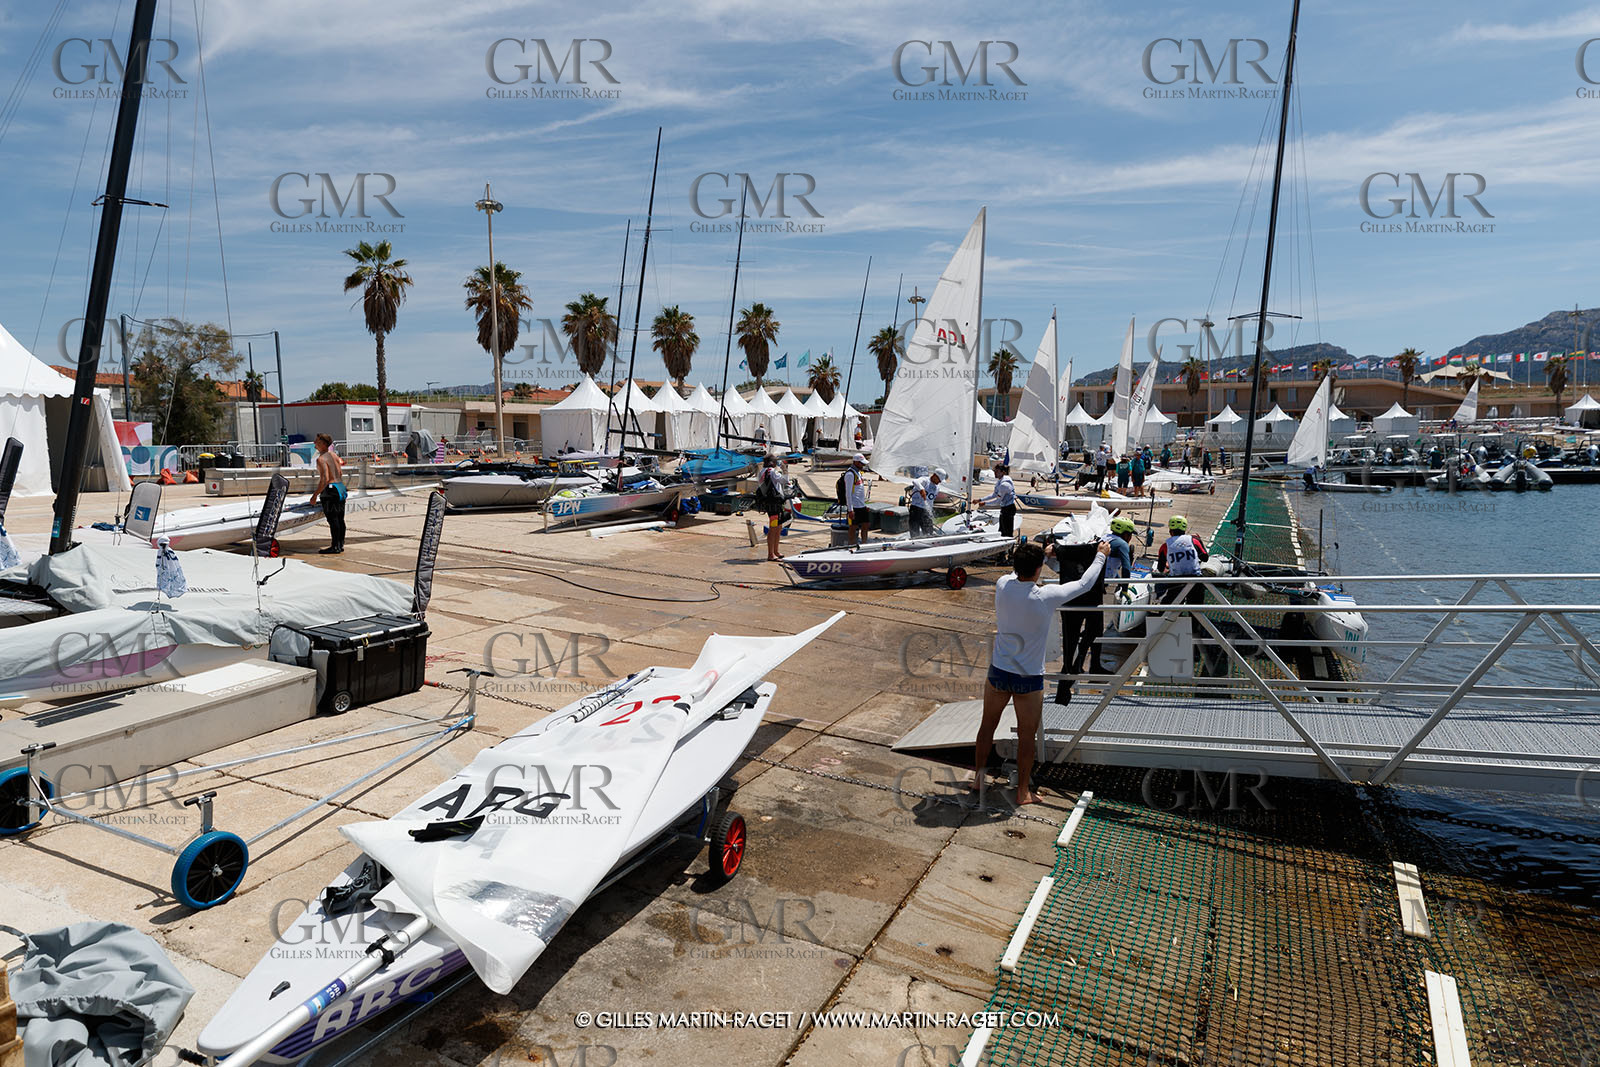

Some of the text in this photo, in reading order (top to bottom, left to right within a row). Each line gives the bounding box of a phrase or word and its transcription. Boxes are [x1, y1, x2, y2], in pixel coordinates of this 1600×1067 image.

[557, 501, 581, 514] JPN
[1025, 497, 1041, 505] POL
[1169, 550, 1196, 563] JPN
[806, 562, 842, 574] POR
[312, 959, 444, 1042] ARG
